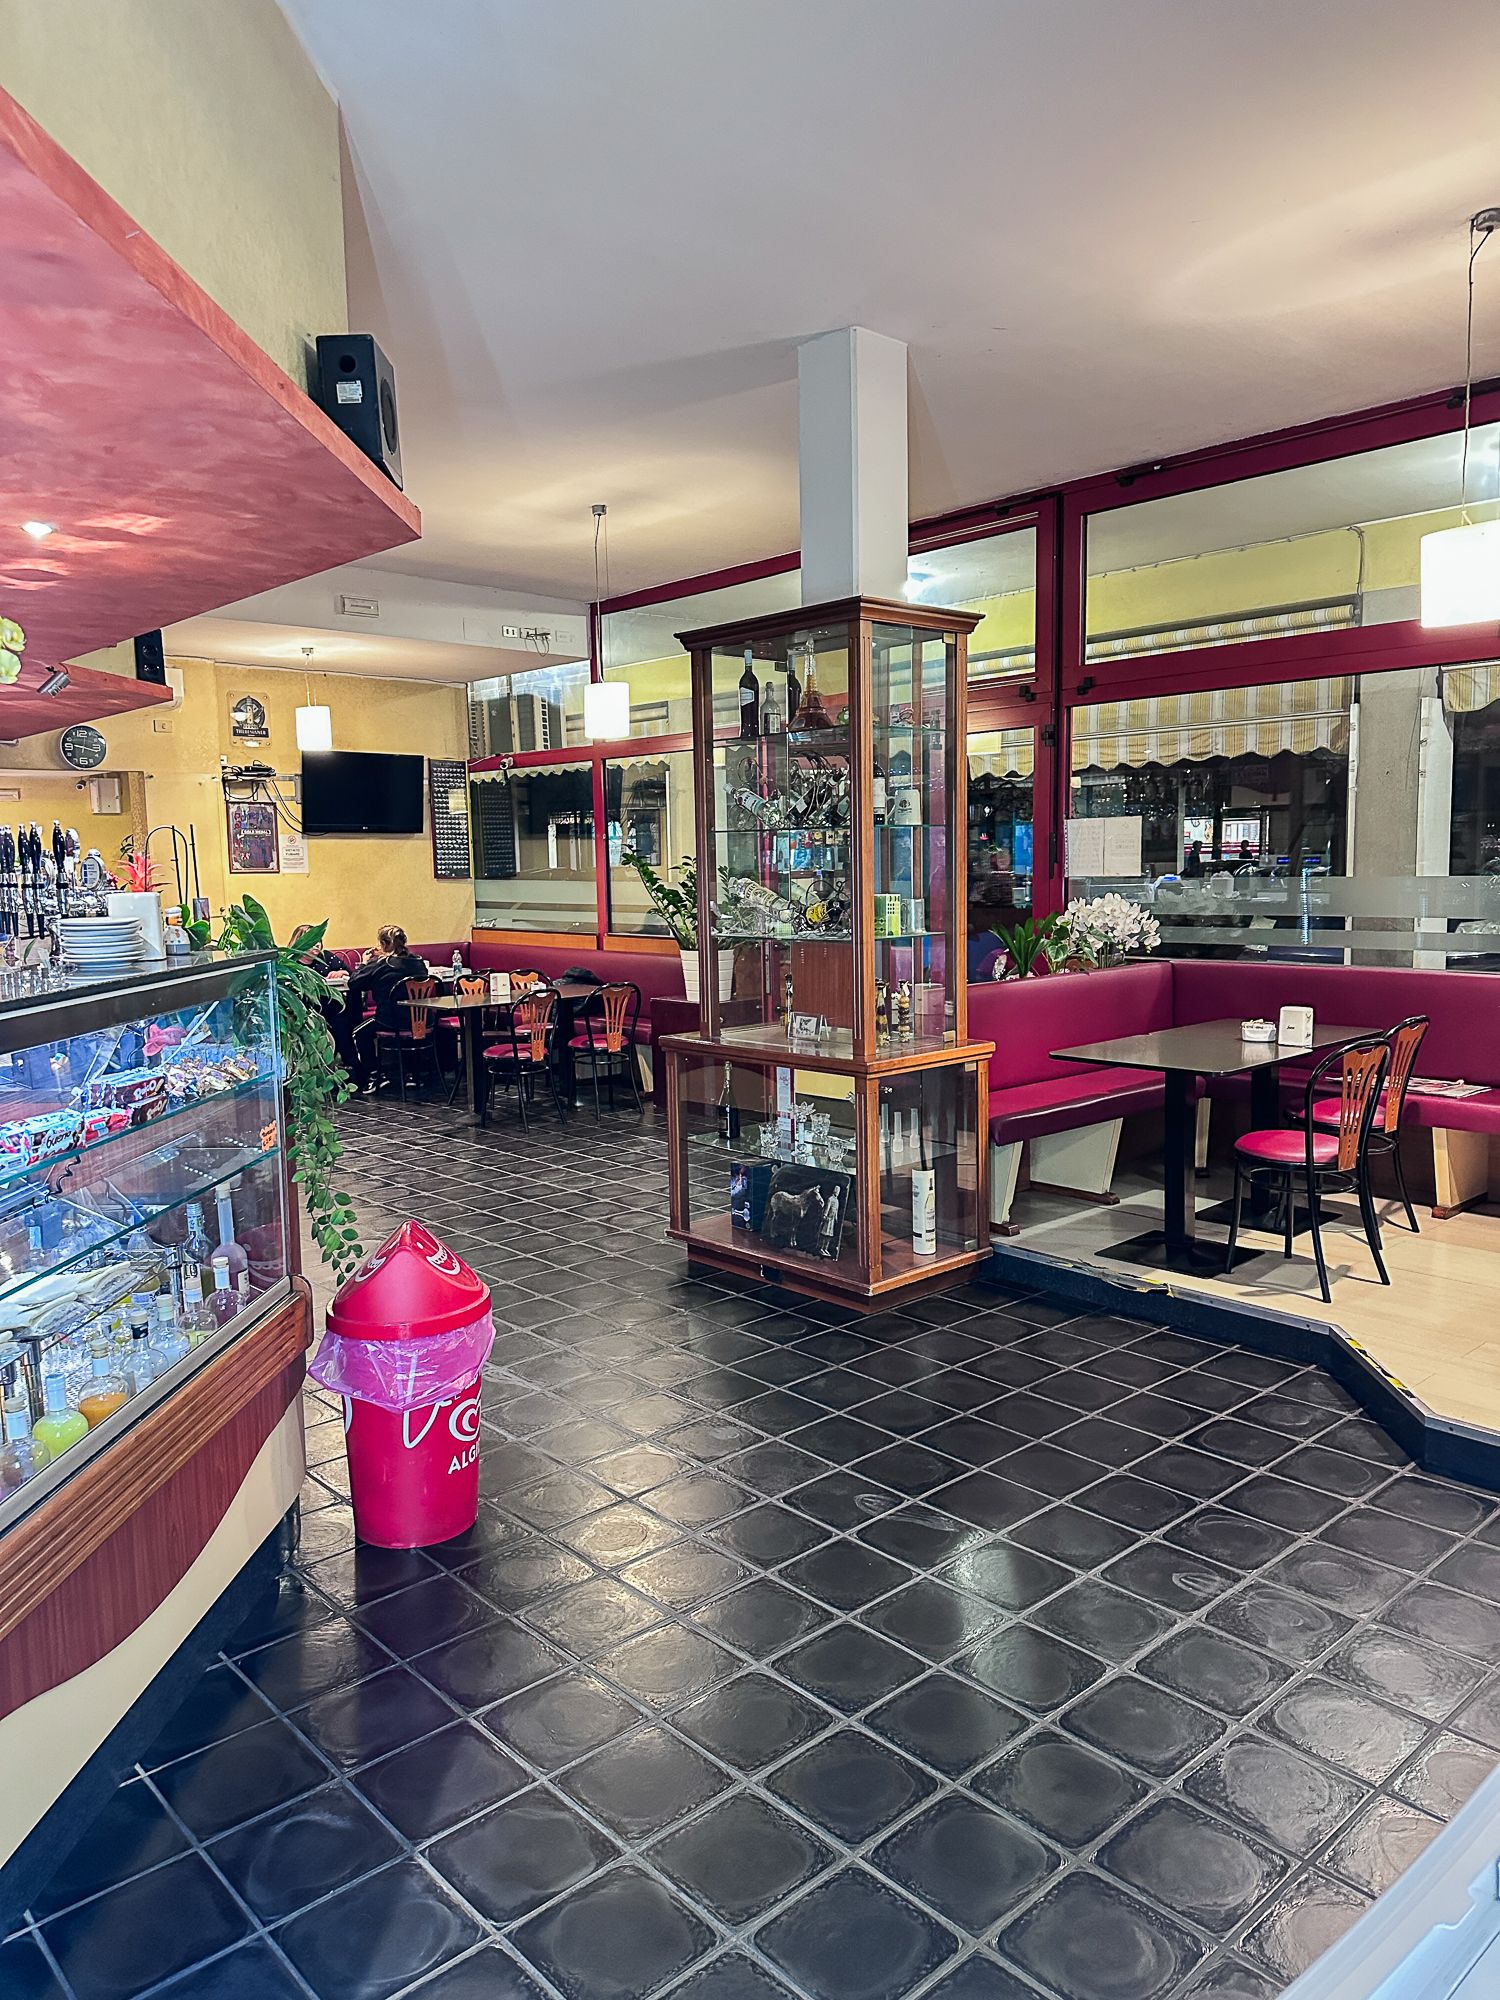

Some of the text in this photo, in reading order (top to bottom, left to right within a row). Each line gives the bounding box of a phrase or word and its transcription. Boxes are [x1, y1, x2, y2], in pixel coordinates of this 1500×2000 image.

[76, 730, 88, 738] 12
[64, 742, 74, 751] 9
[79, 757, 89, 765] 6
[46, 1130, 72, 1149] bueno
[447, 1437, 480, 1475] ALGI
